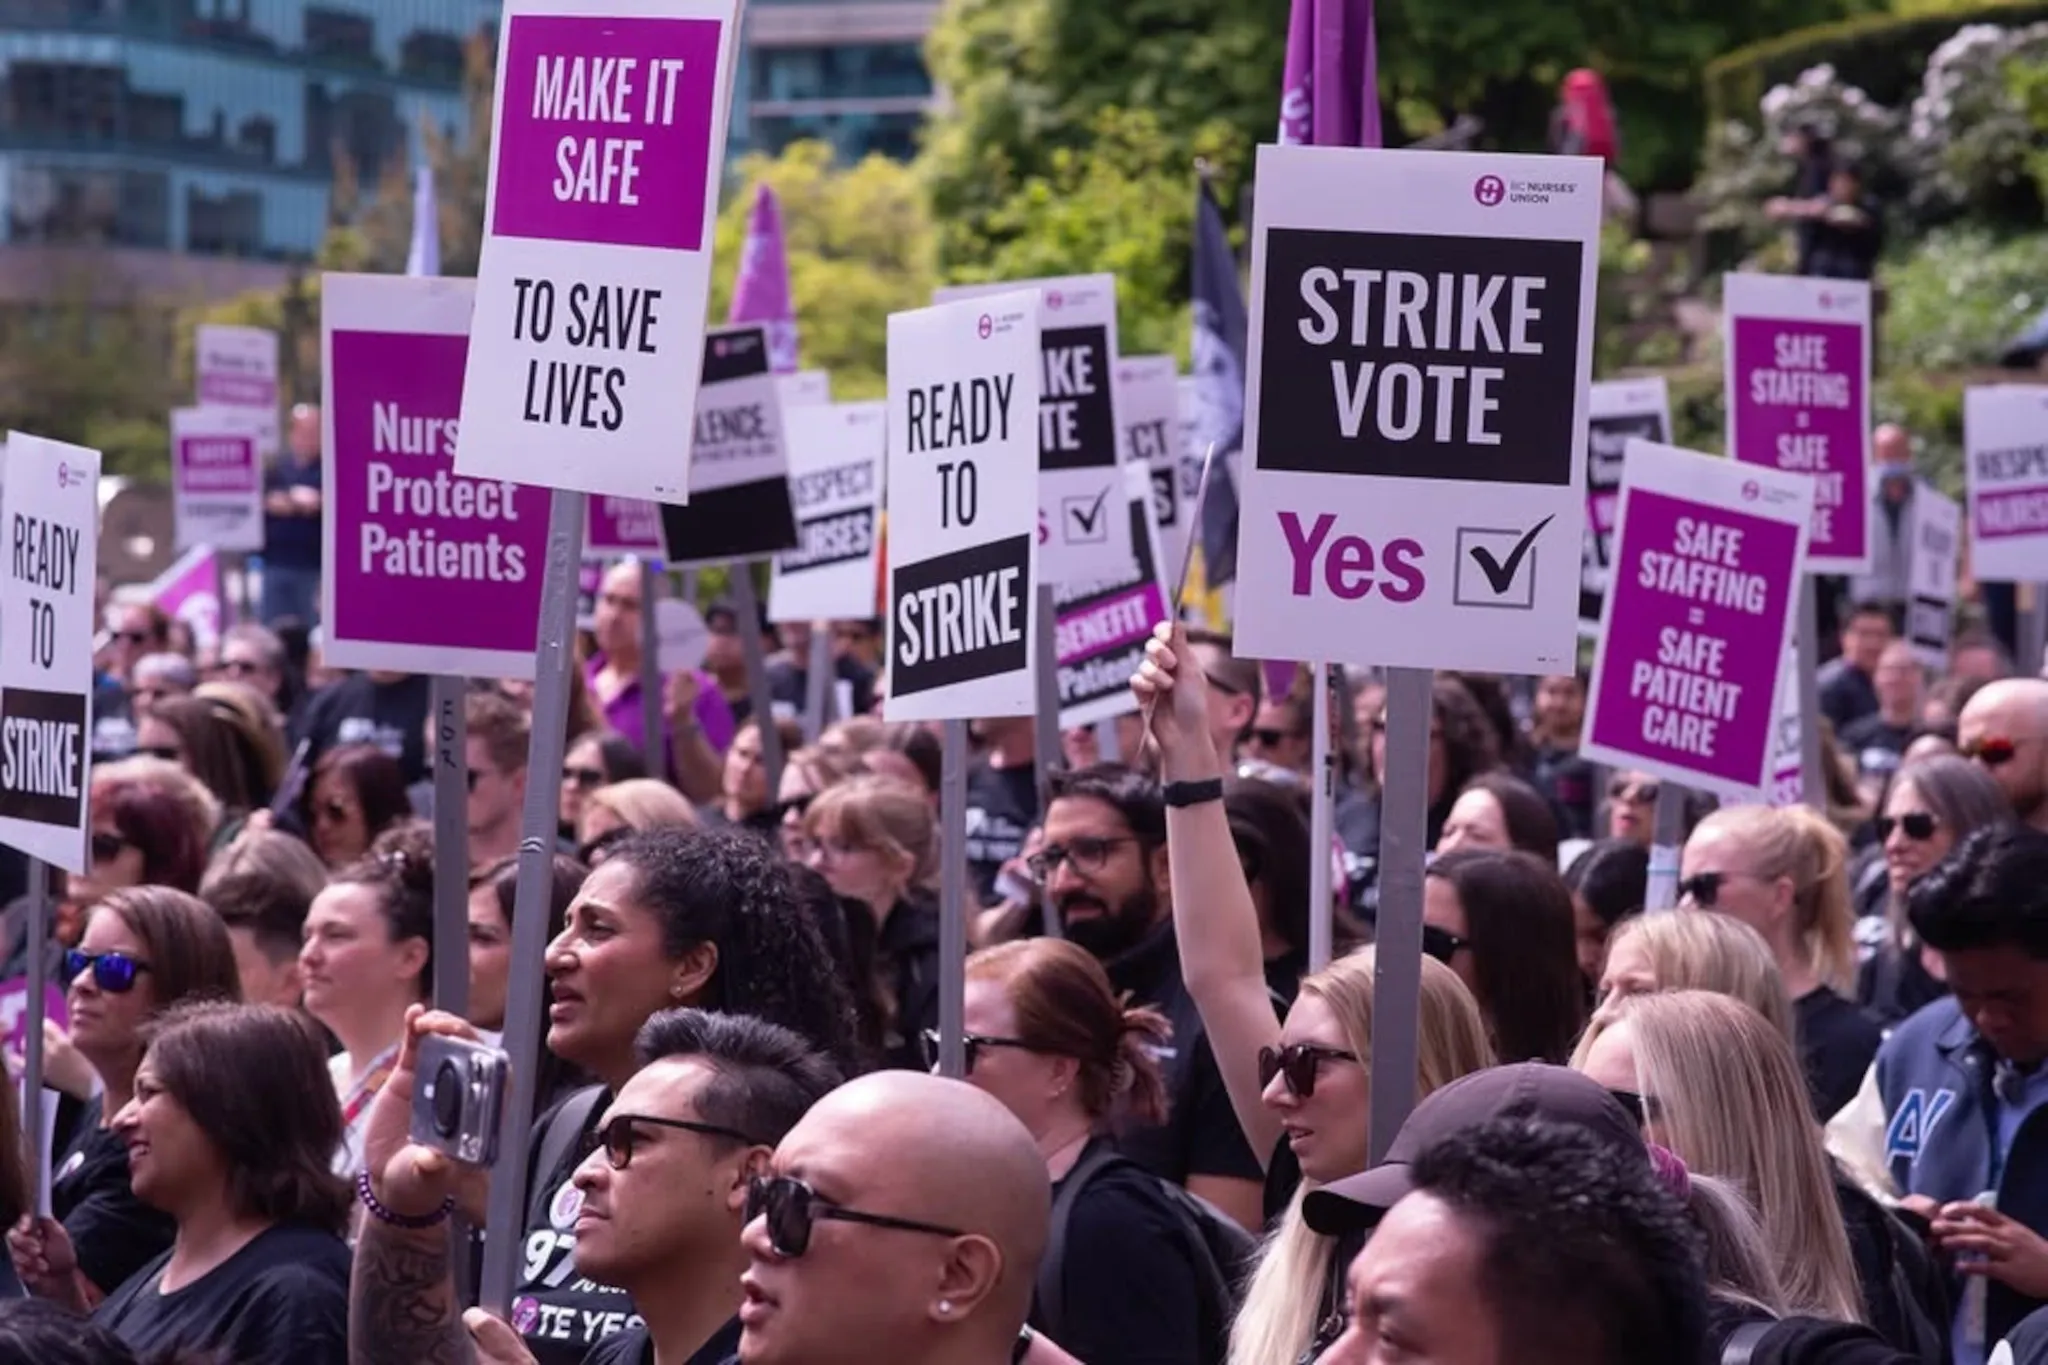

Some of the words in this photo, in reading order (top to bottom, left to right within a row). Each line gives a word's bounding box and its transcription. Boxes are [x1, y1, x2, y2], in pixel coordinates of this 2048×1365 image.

[532, 55, 637, 123] MAKE
[645, 58, 685, 126] IT
[553, 135, 644, 206] SAFE
[1510, 194, 1549, 203] UNION
[513, 278, 555, 343] TO
[566, 282, 662, 354] SAVE
[1298, 265, 1547, 355] STRIKE
[1774, 332, 1828, 370] SAFE
[524, 359, 626, 432] LIVES
[908, 373, 1014, 454] READY
[1330, 359, 1506, 445] VOTE
[1751, 369, 1849, 409] STAFFING
[373, 401, 462, 456] Nurs
[1776, 434, 1829, 470] SAFE
[367, 461, 519, 520] Protect
[937, 461, 978, 529] TO
[13, 512, 79, 595] READY
[360, 522, 526, 583] Patients
[1277, 511, 1427, 604] Yes
[1674, 517, 1744, 567] SAFE
[1638, 549, 1767, 615] STAFFING
[30, 600, 54, 669] TO
[899, 566, 1022, 668] STRIKE
[1657, 626, 1727, 677] SAFE
[1630, 660, 1741, 721] PATIENT
[2, 716, 80, 798] STRIKE
[1641, 705, 1718, 757] CARE
